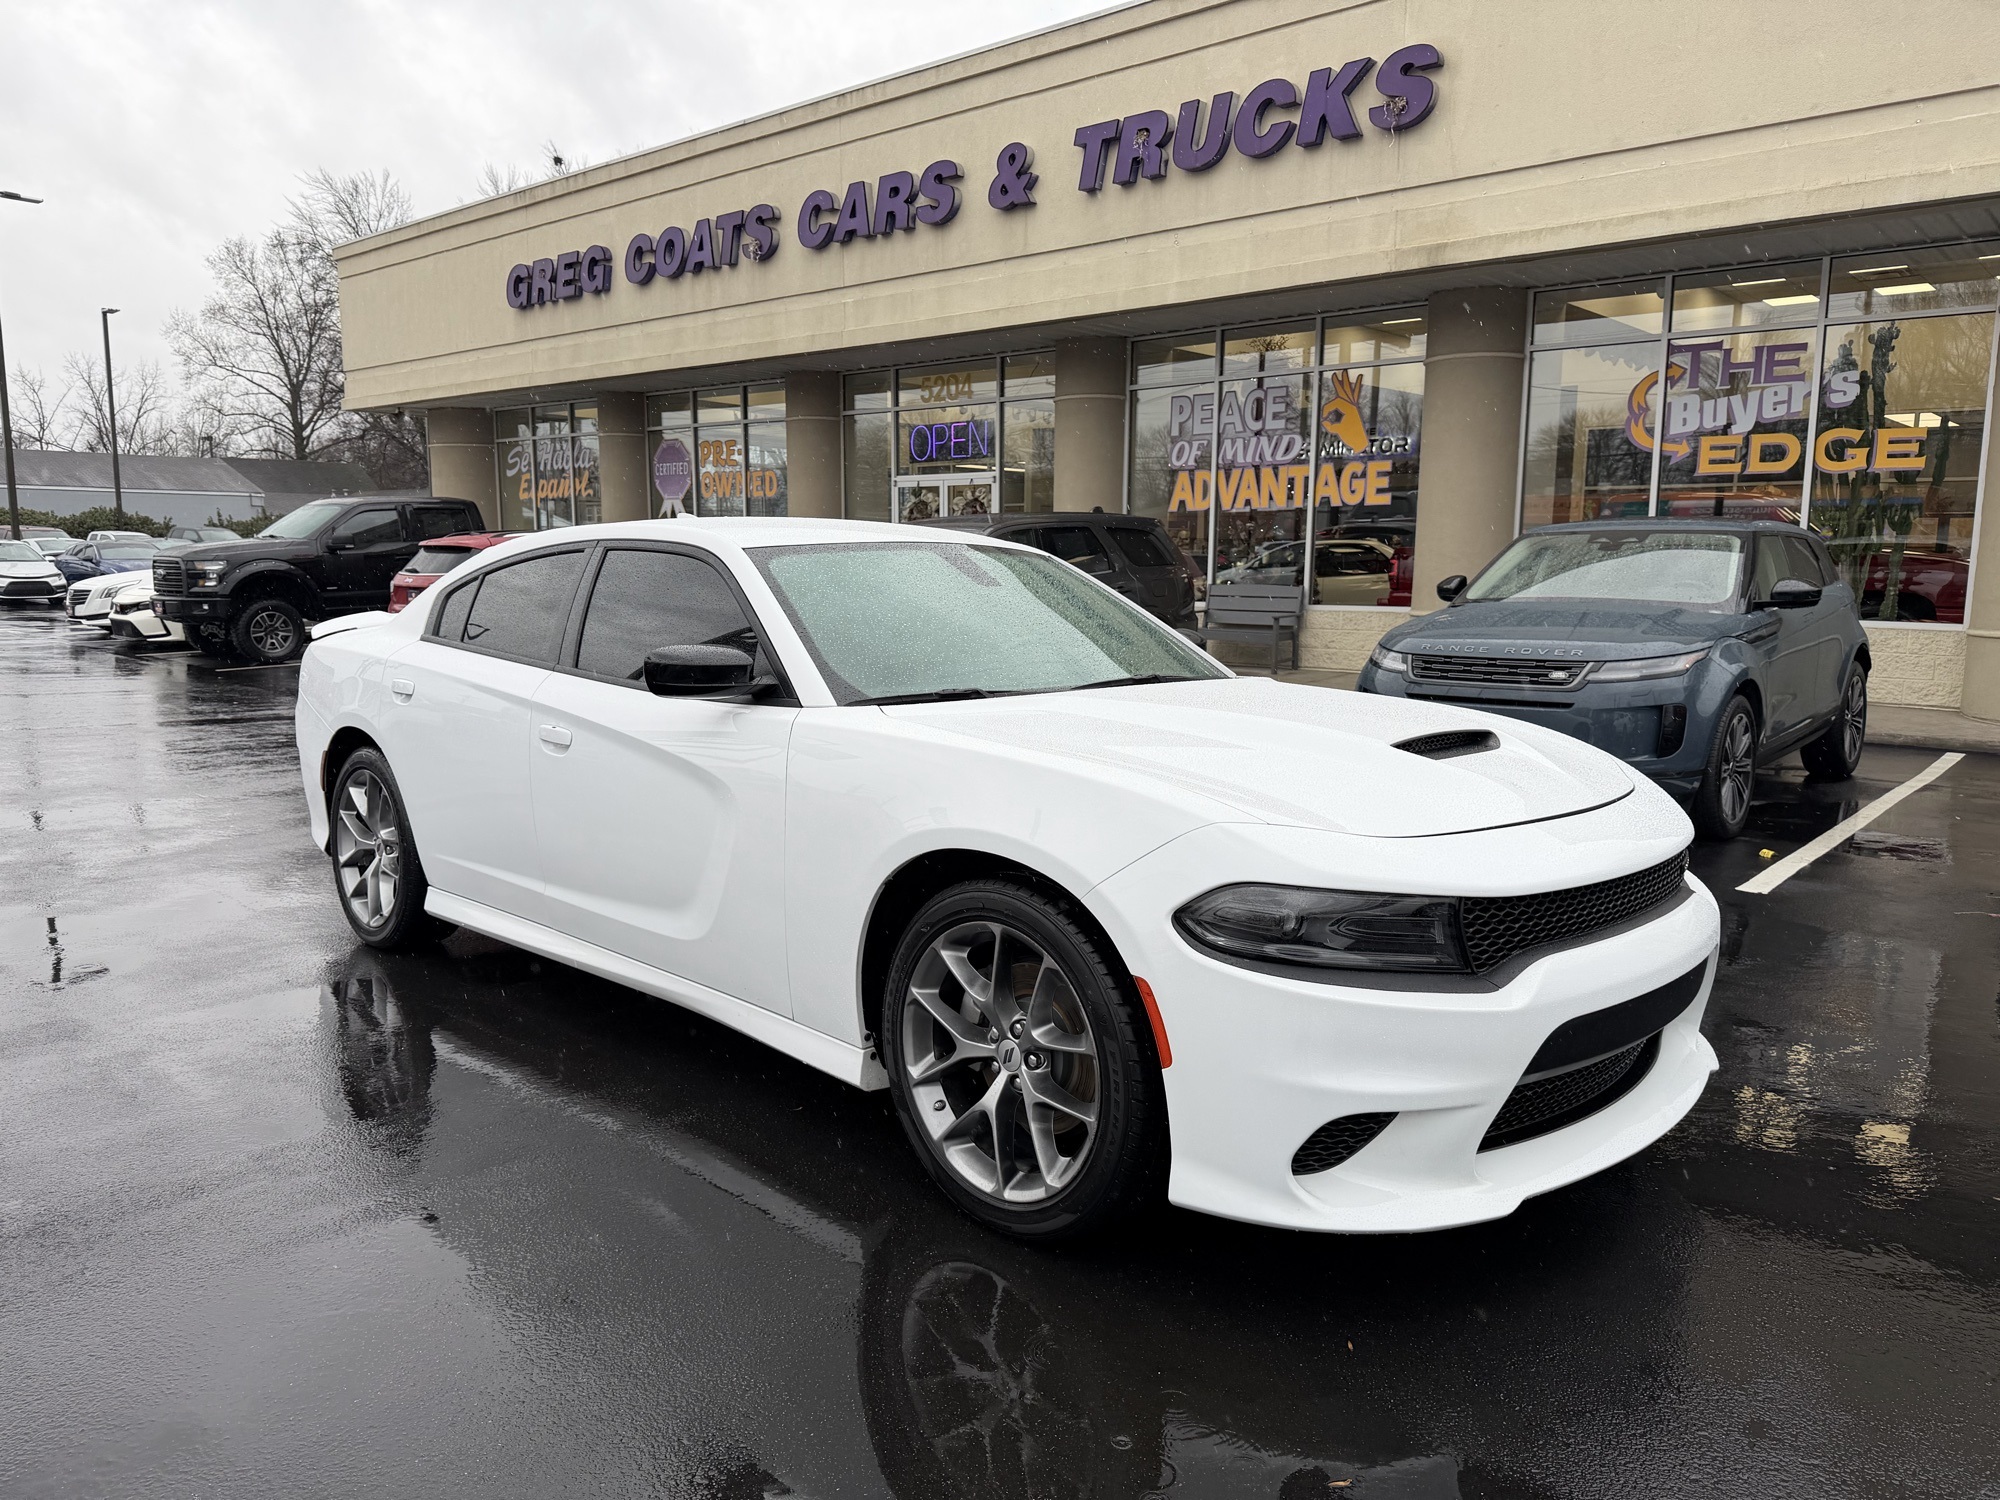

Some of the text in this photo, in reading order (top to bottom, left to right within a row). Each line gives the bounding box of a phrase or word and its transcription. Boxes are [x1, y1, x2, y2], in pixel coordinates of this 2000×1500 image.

[506, 43, 1445, 310] GREG COATS CARS & TRUCKS
[1669, 340, 1808, 389] THE
[920, 373, 974, 403] 5204
[1171, 386, 1288, 436] PEACE
[701, 440, 742, 468] PRE-
[910, 421, 988, 461] OPEN
[1170, 434, 1301, 468] OF MIND
[1694, 427, 1928, 476] EDGE
[506, 445, 531, 477] Se
[655, 462, 689, 476] CERTIFIED
[701, 470, 777, 498] OWNED
[1168, 460, 1392, 512] ADVANTAGE
[1420, 643, 1583, 657] RANGE ROVER
